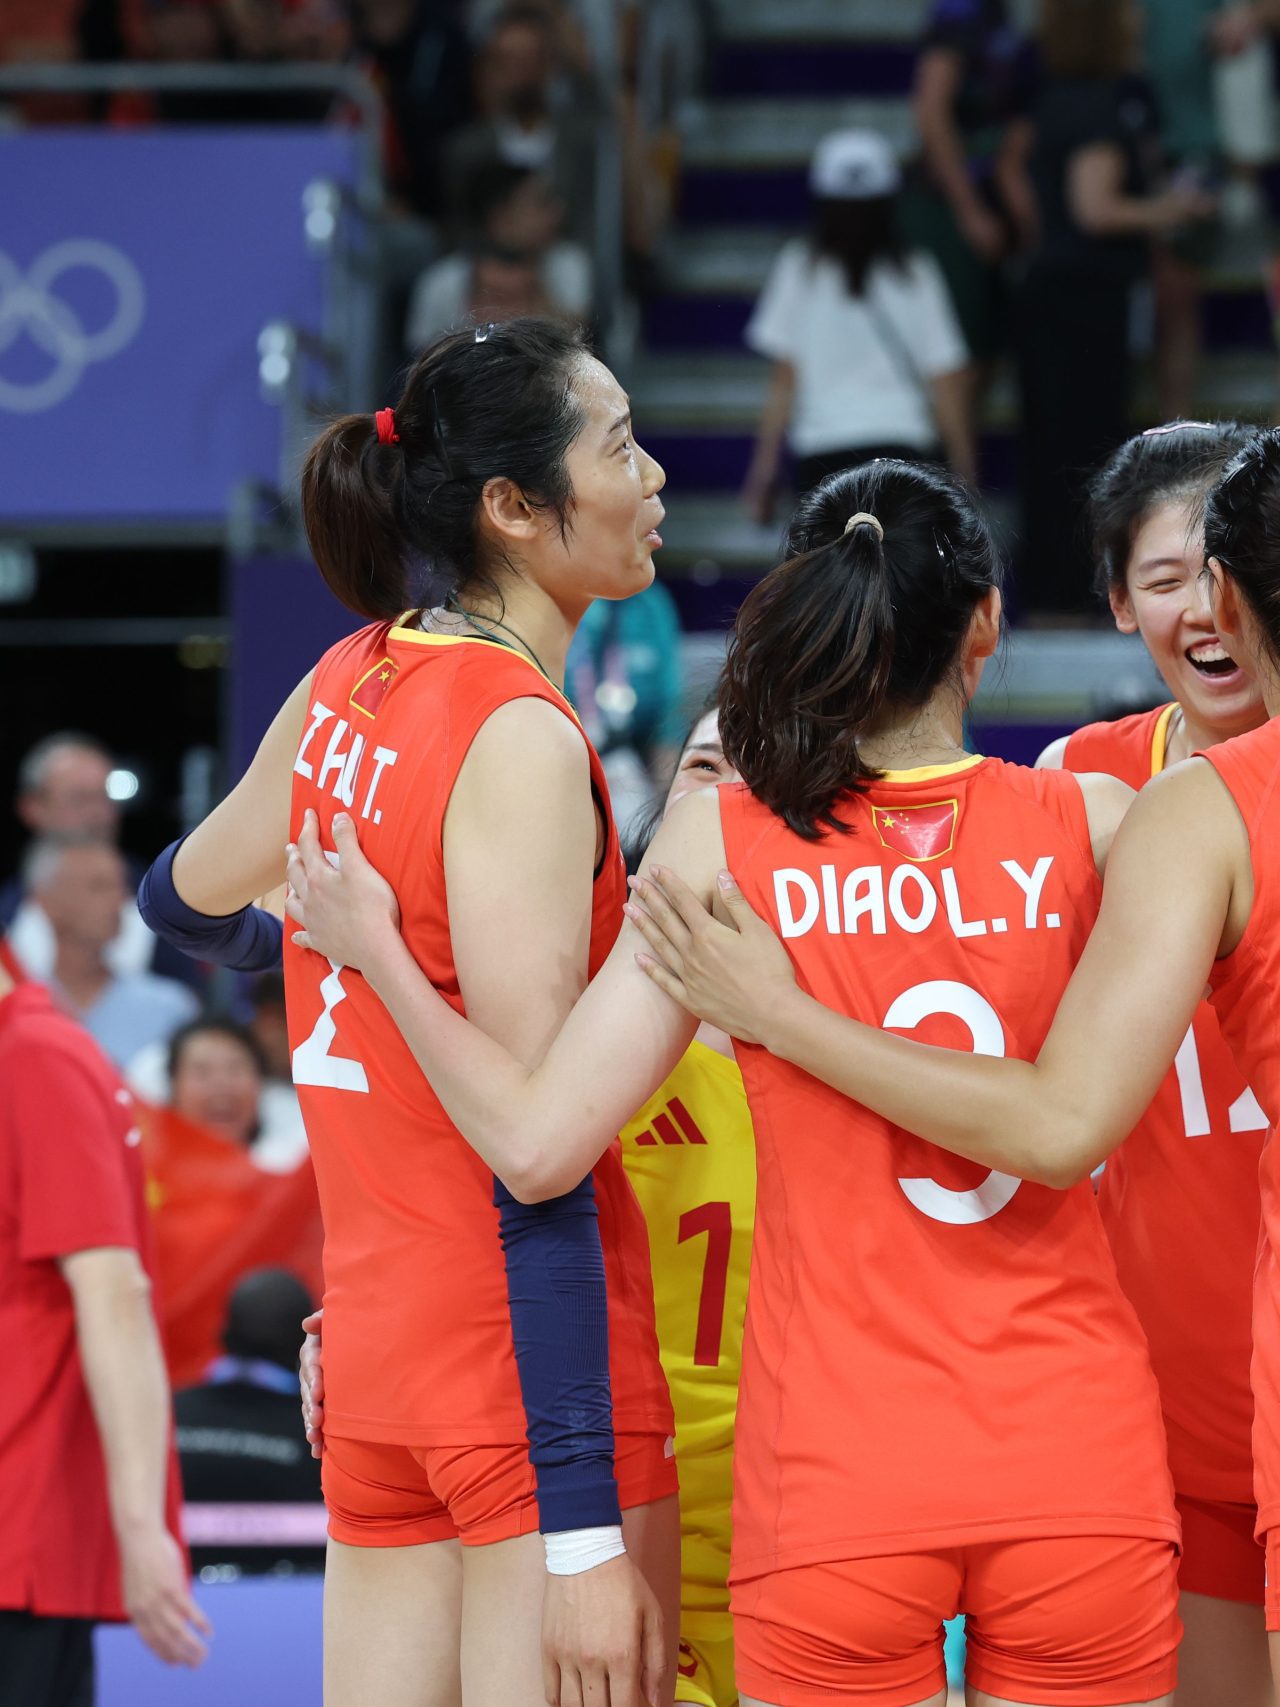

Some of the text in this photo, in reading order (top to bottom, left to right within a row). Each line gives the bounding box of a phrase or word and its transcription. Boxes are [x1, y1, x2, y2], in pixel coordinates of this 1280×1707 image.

[361, 745, 398, 825] T.
[773, 856, 1061, 939] DIAO L.Y.
[883, 979, 1022, 1225] 3
[677, 1201, 732, 1367] 1
